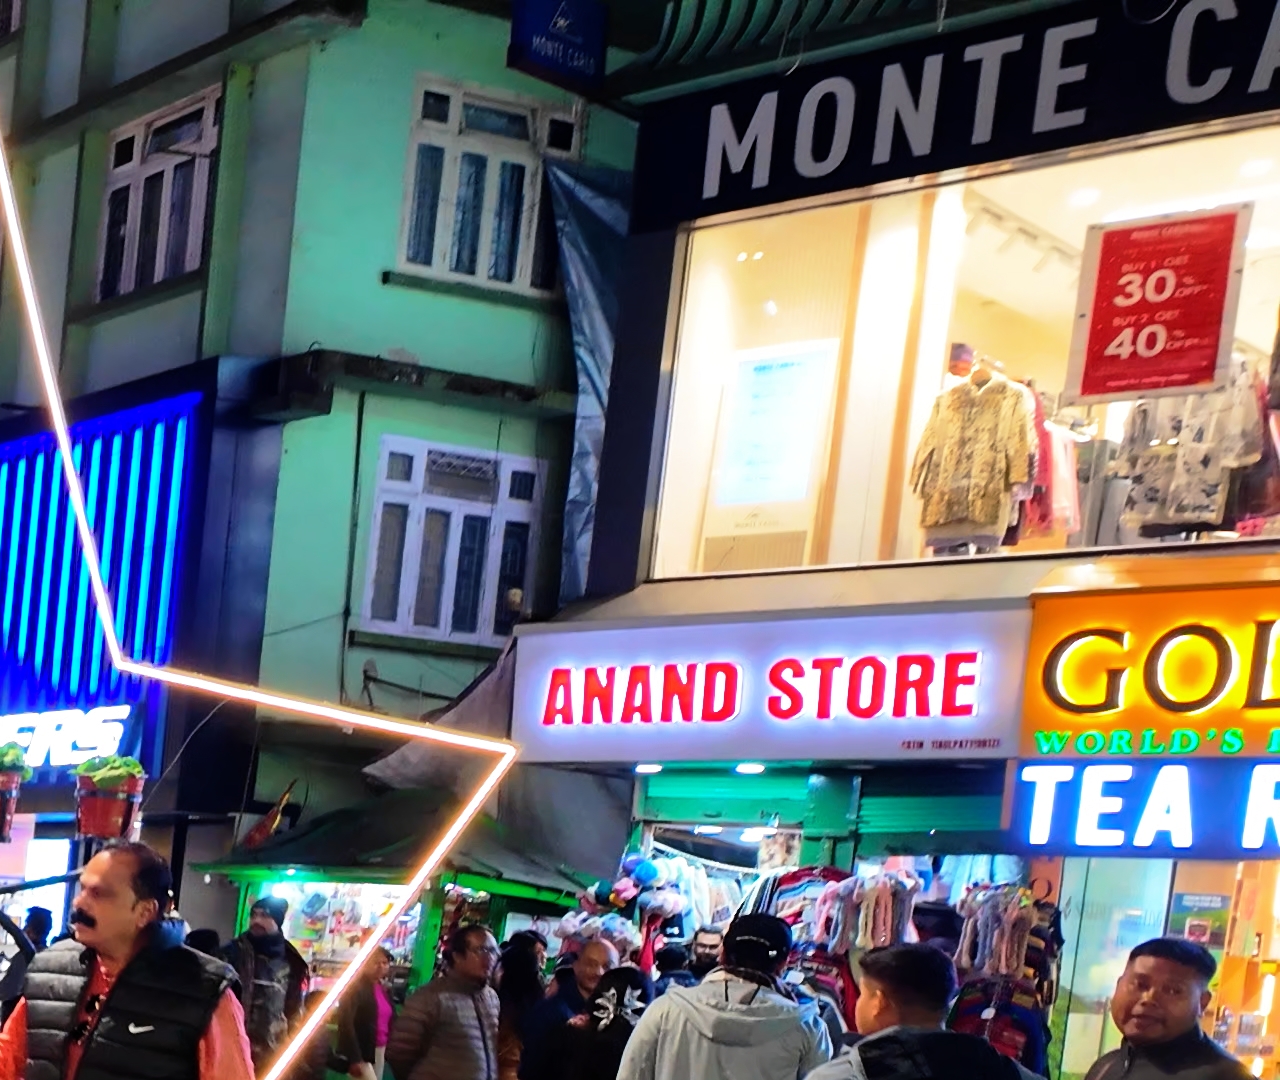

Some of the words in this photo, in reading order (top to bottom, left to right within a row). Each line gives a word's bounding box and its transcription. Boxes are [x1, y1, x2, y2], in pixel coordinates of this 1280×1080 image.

[702, 18, 1098, 199] MONTE
[1112, 268, 1177, 308] 30
[1103, 323, 1168, 361] 40
[542, 661, 742, 726] ANAND
[768, 652, 982, 720] STORE
[1034, 728, 1245, 755] WORLD'S
[1021, 764, 1193, 848] TEA
